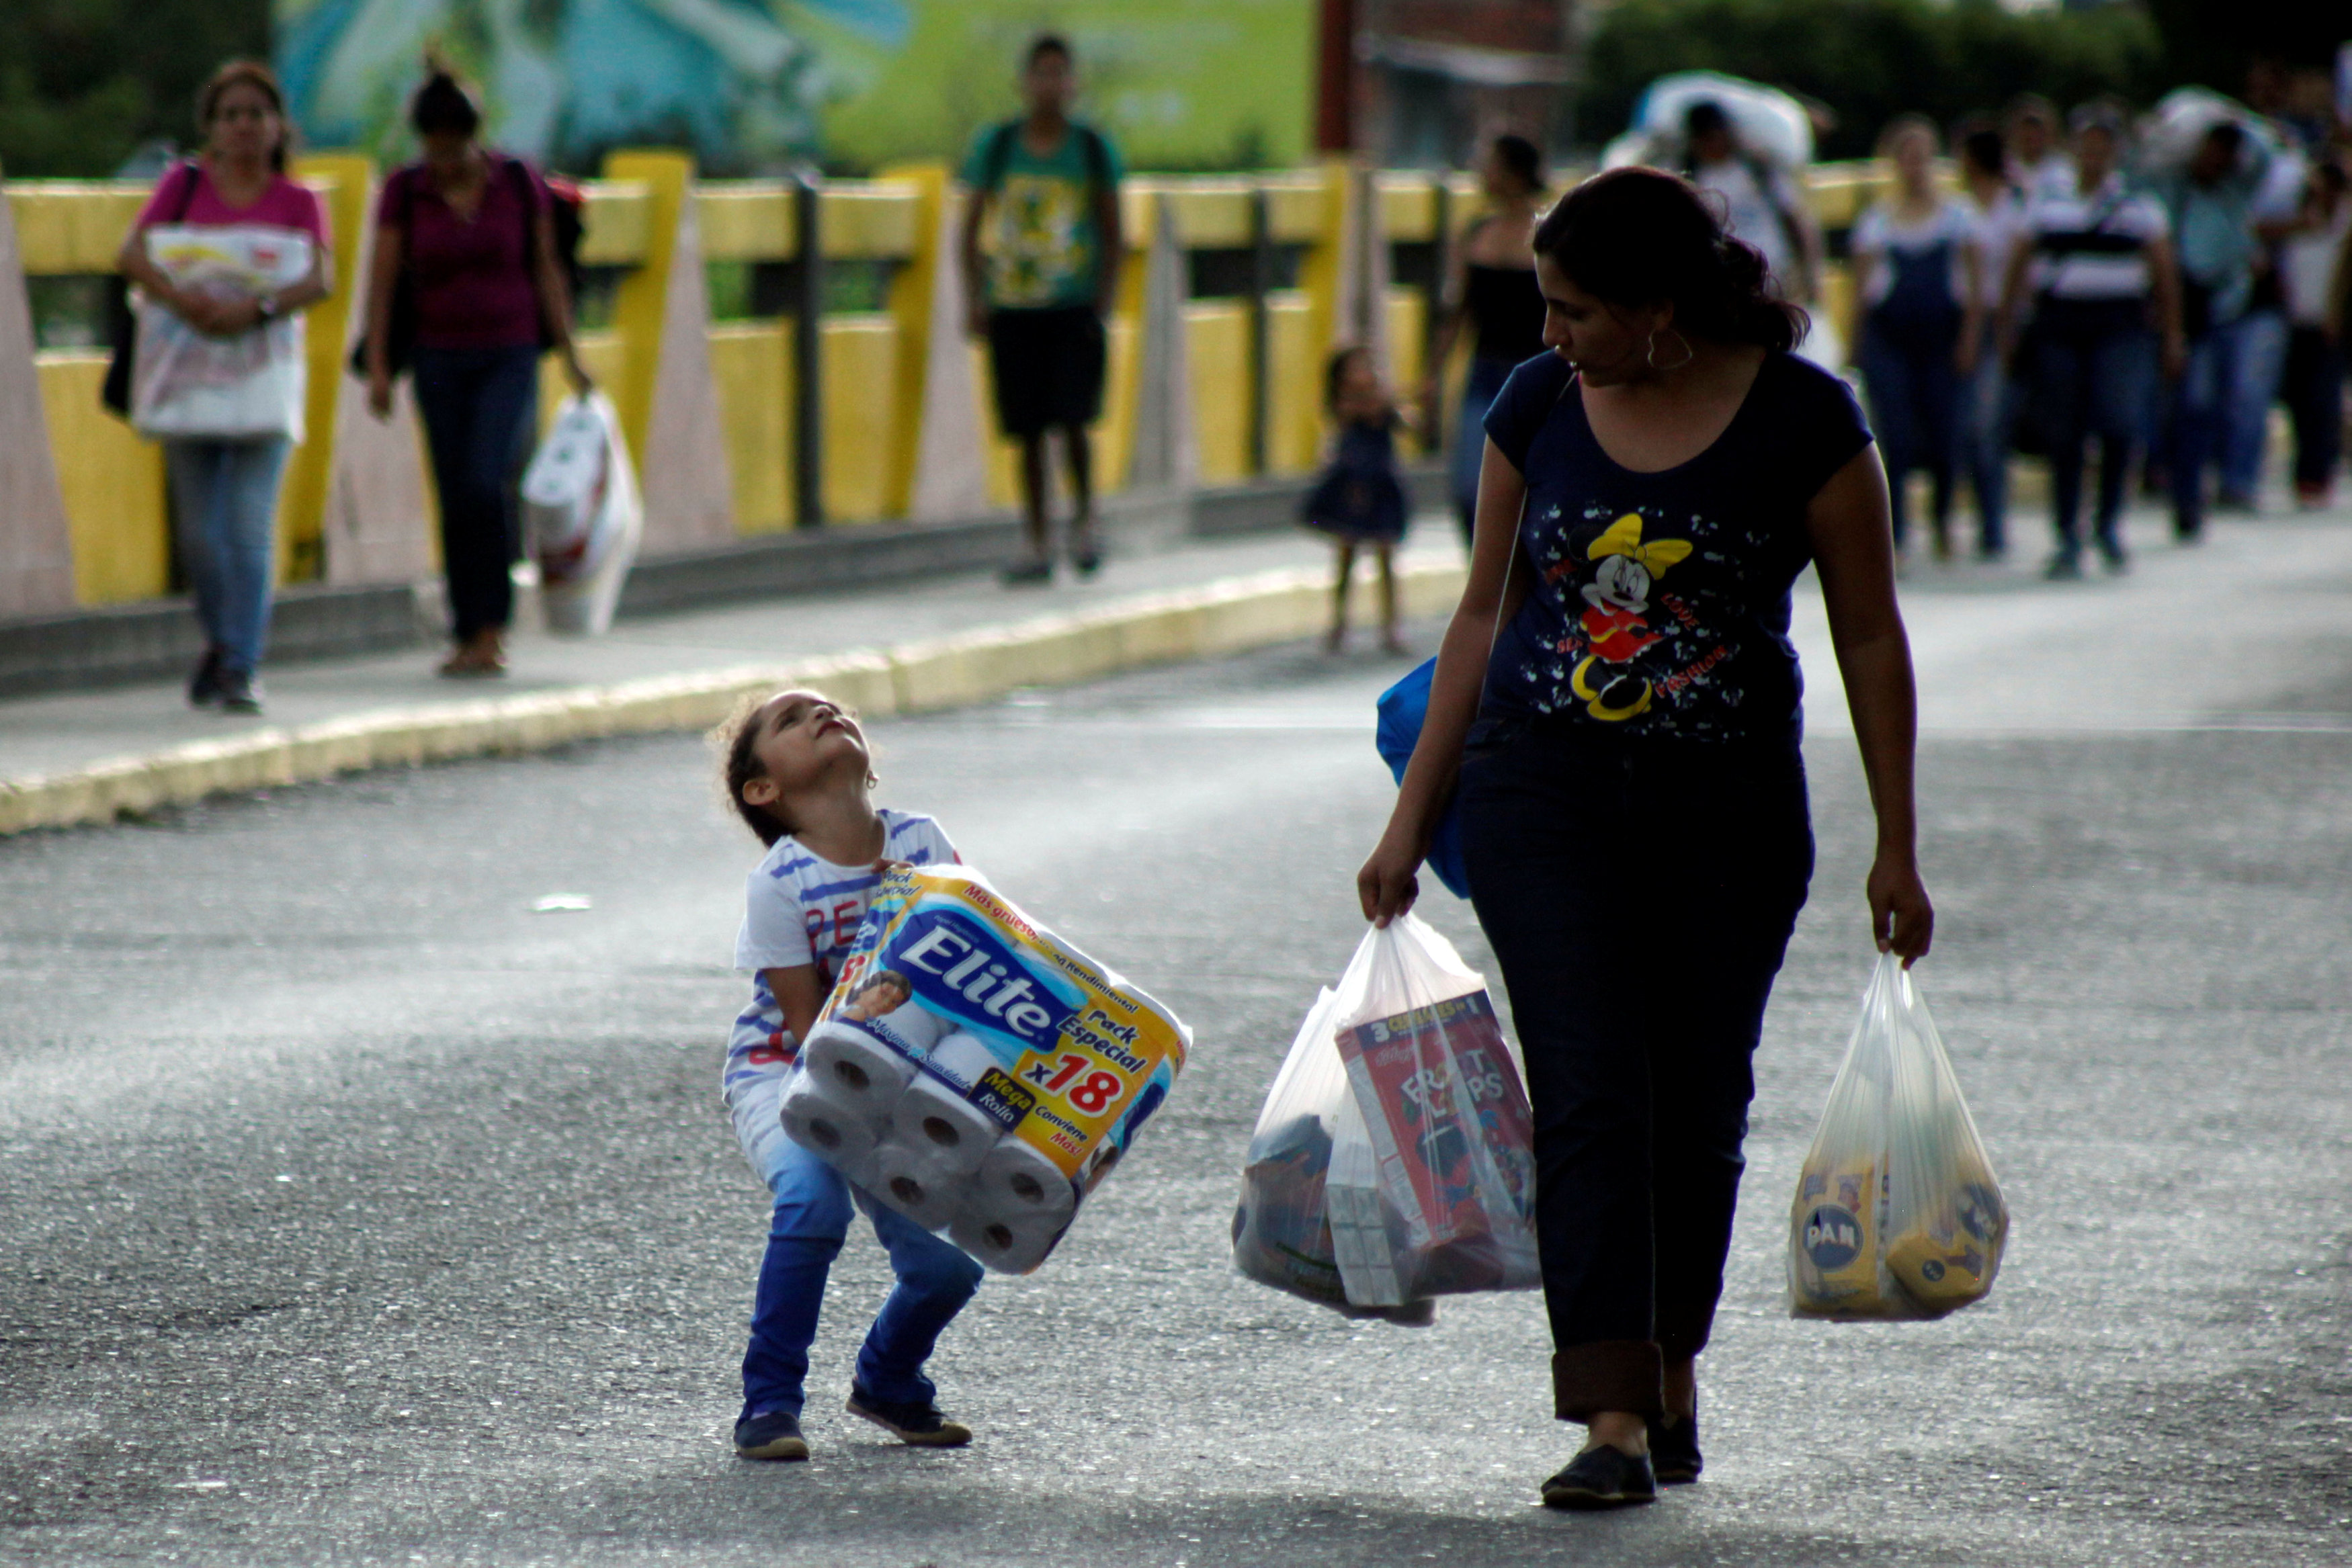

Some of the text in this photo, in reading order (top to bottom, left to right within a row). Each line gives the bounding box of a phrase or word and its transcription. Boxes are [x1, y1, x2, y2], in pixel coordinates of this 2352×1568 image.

[1655, 645, 1728, 699] FASHION
[964, 885, 993, 909] Más
[899, 924, 1051, 1037] Elite
[1057, 1016, 1146, 1074] Especial
[1087, 1010, 1137, 1044] Pack
[1371, 1022, 1390, 1042] 3
[921, 1052, 969, 1088] Suavidad
[978, 1092, 1014, 1123] Rollo
[984, 1072, 1032, 1110] Mega
[1035, 1106, 1088, 1143] Conviene
